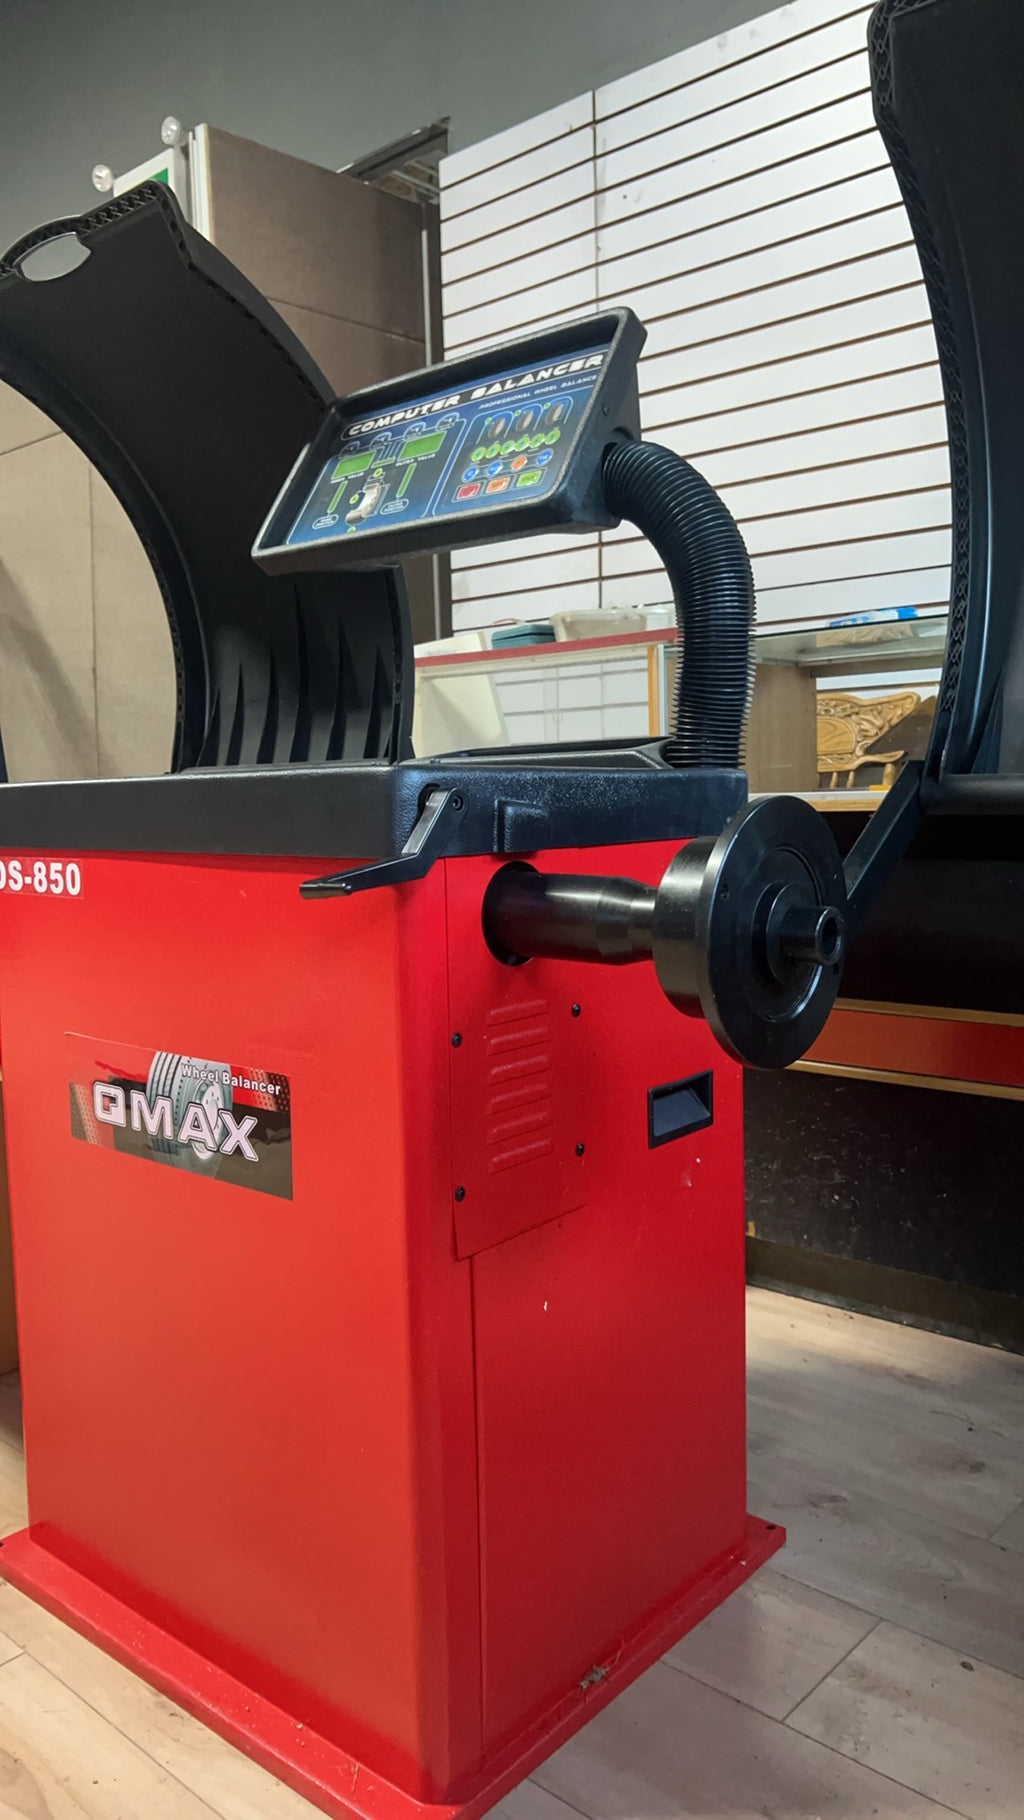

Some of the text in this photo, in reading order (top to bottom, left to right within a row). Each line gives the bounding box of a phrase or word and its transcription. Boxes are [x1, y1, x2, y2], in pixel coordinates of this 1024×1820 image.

[348, 354, 604, 436] COMPUTER BALANCER
[180, 1062, 281, 1096] Wheel Balancer
[92, 1080, 259, 1162] QMAX
